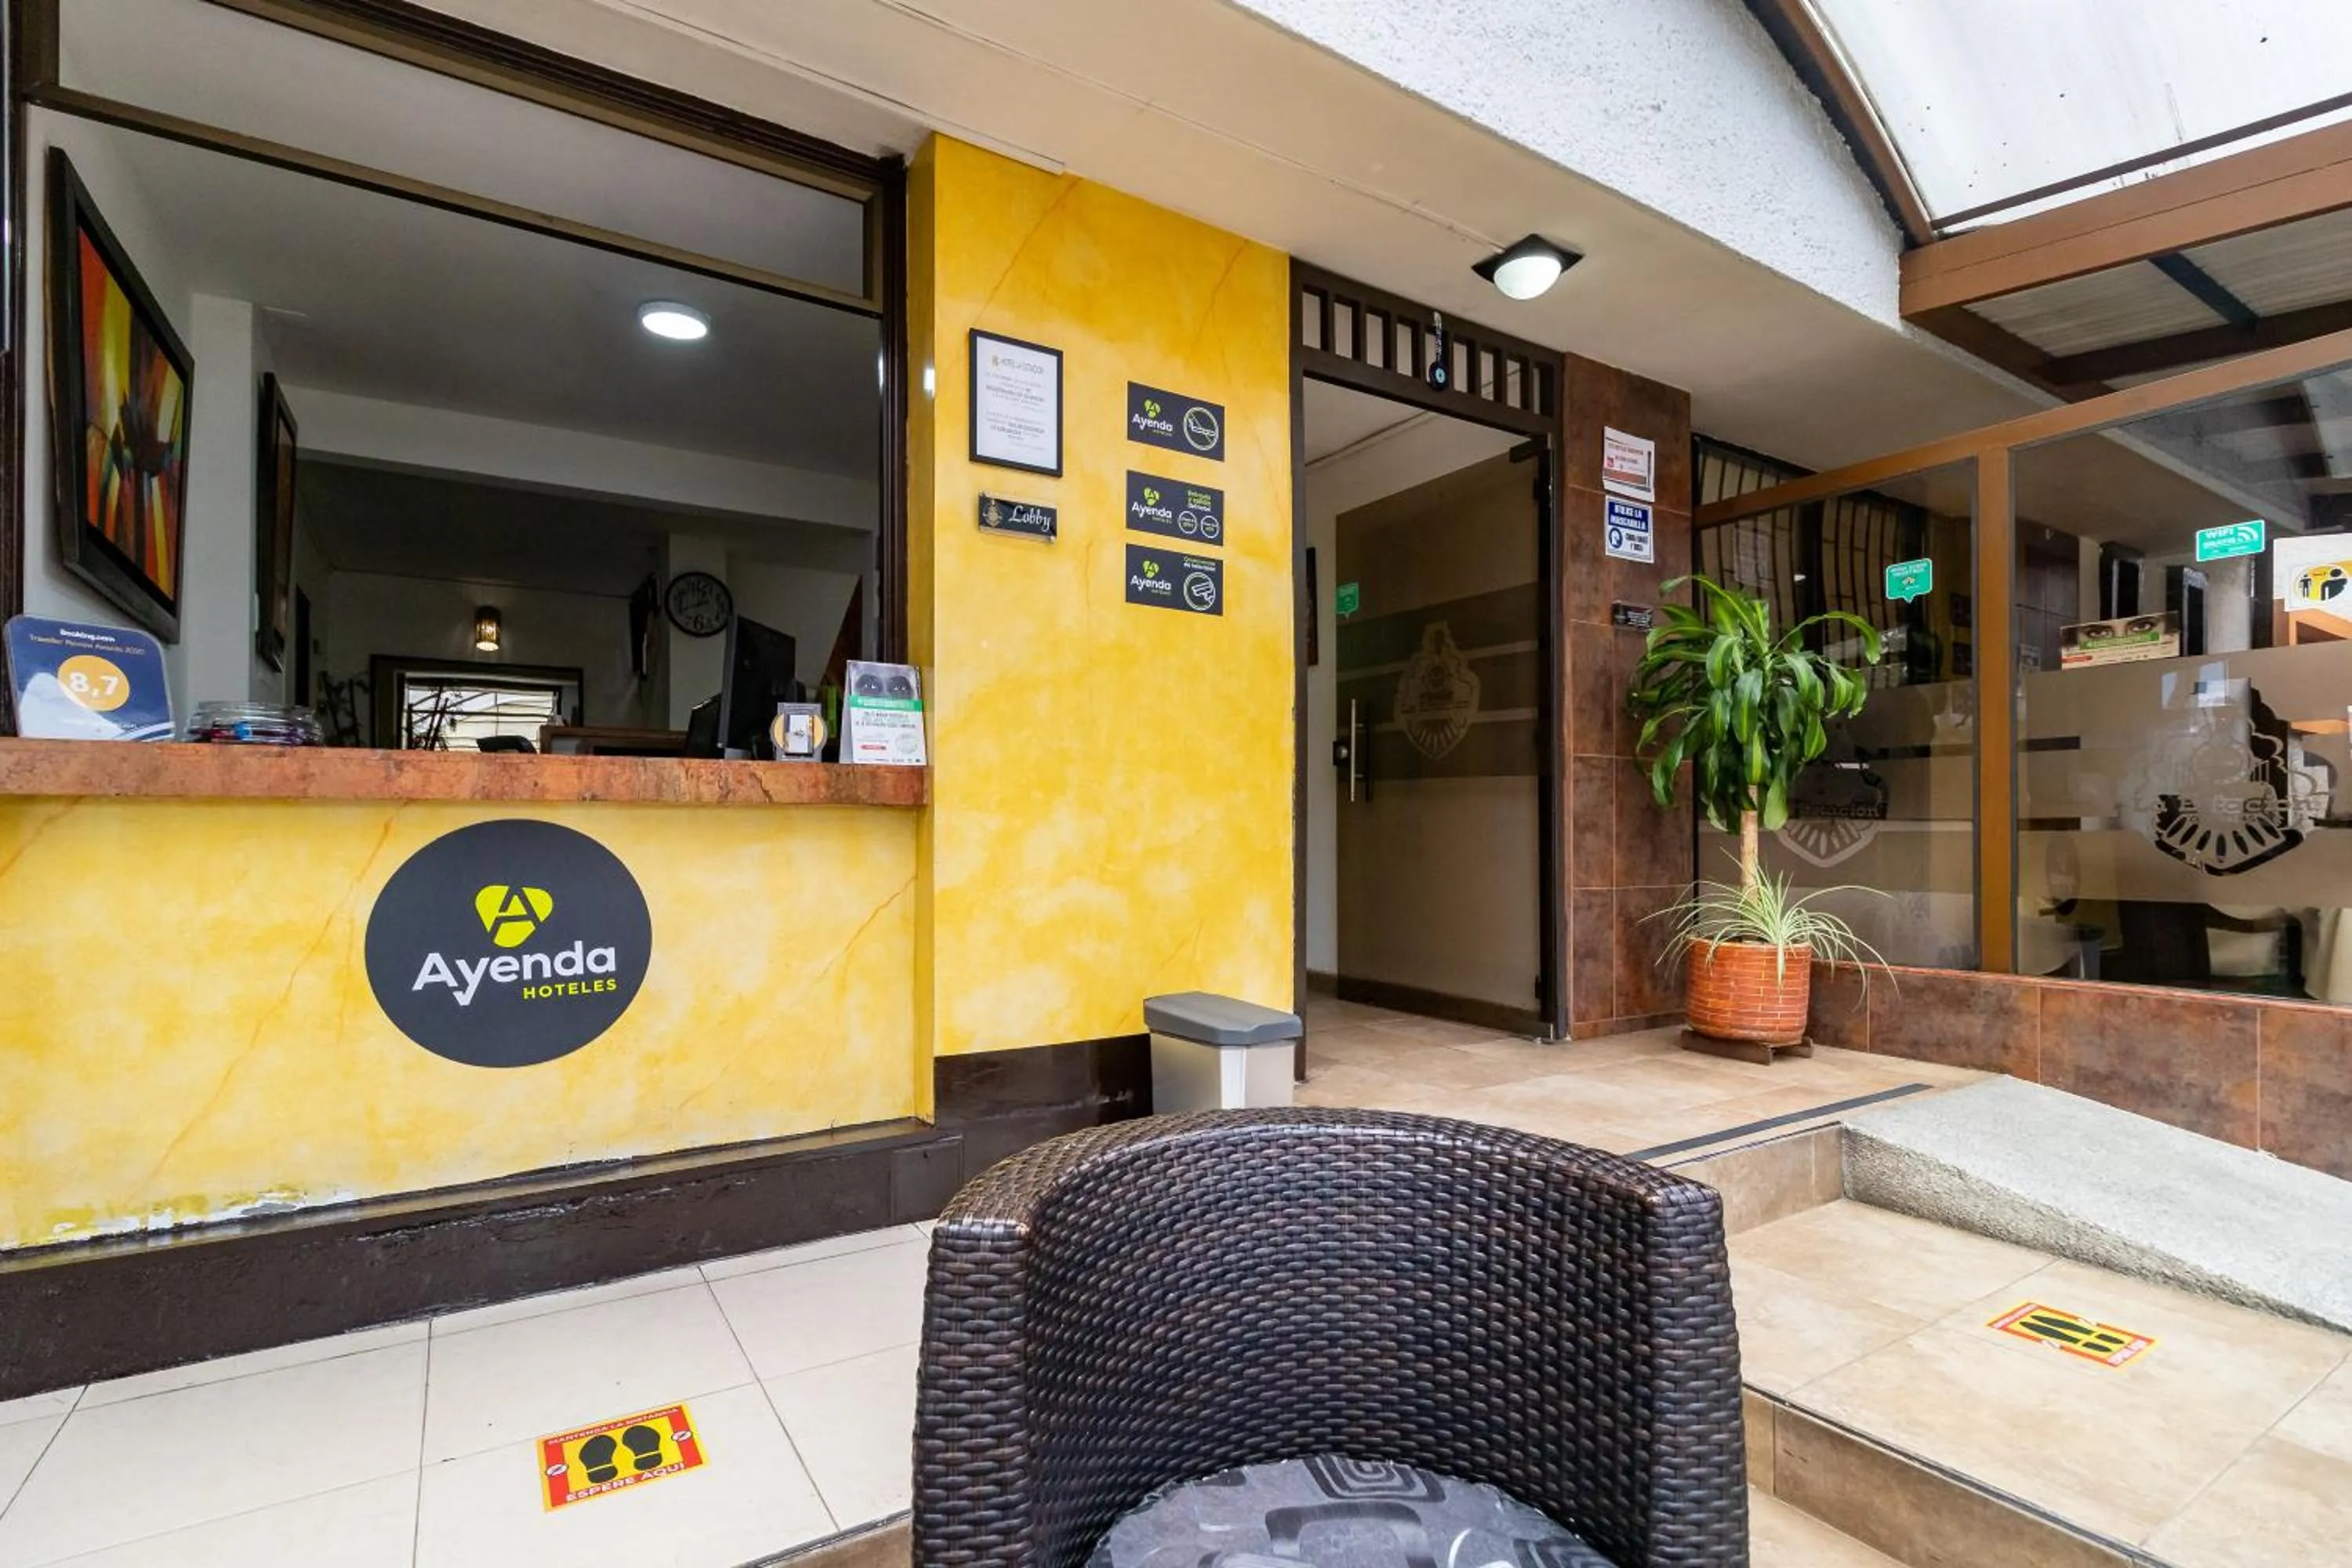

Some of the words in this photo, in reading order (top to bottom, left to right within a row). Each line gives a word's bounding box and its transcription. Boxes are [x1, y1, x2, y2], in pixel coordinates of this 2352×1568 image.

[1132, 413, 1173, 432] Ayenda
[1008, 505, 1051, 532] Lobby
[1131, 501, 1172, 518] Ayenda
[1131, 575, 1172, 592] Ayenda
[68, 671, 119, 698] 8,7
[412, 941, 616, 1006] Ayenda
[523, 978, 617, 1000] HOTELES
[548, 1425, 608, 1445] MANTENGA
[565, 1476, 636, 1502] ESPERE
[640, 1462, 686, 1481] AQUI
